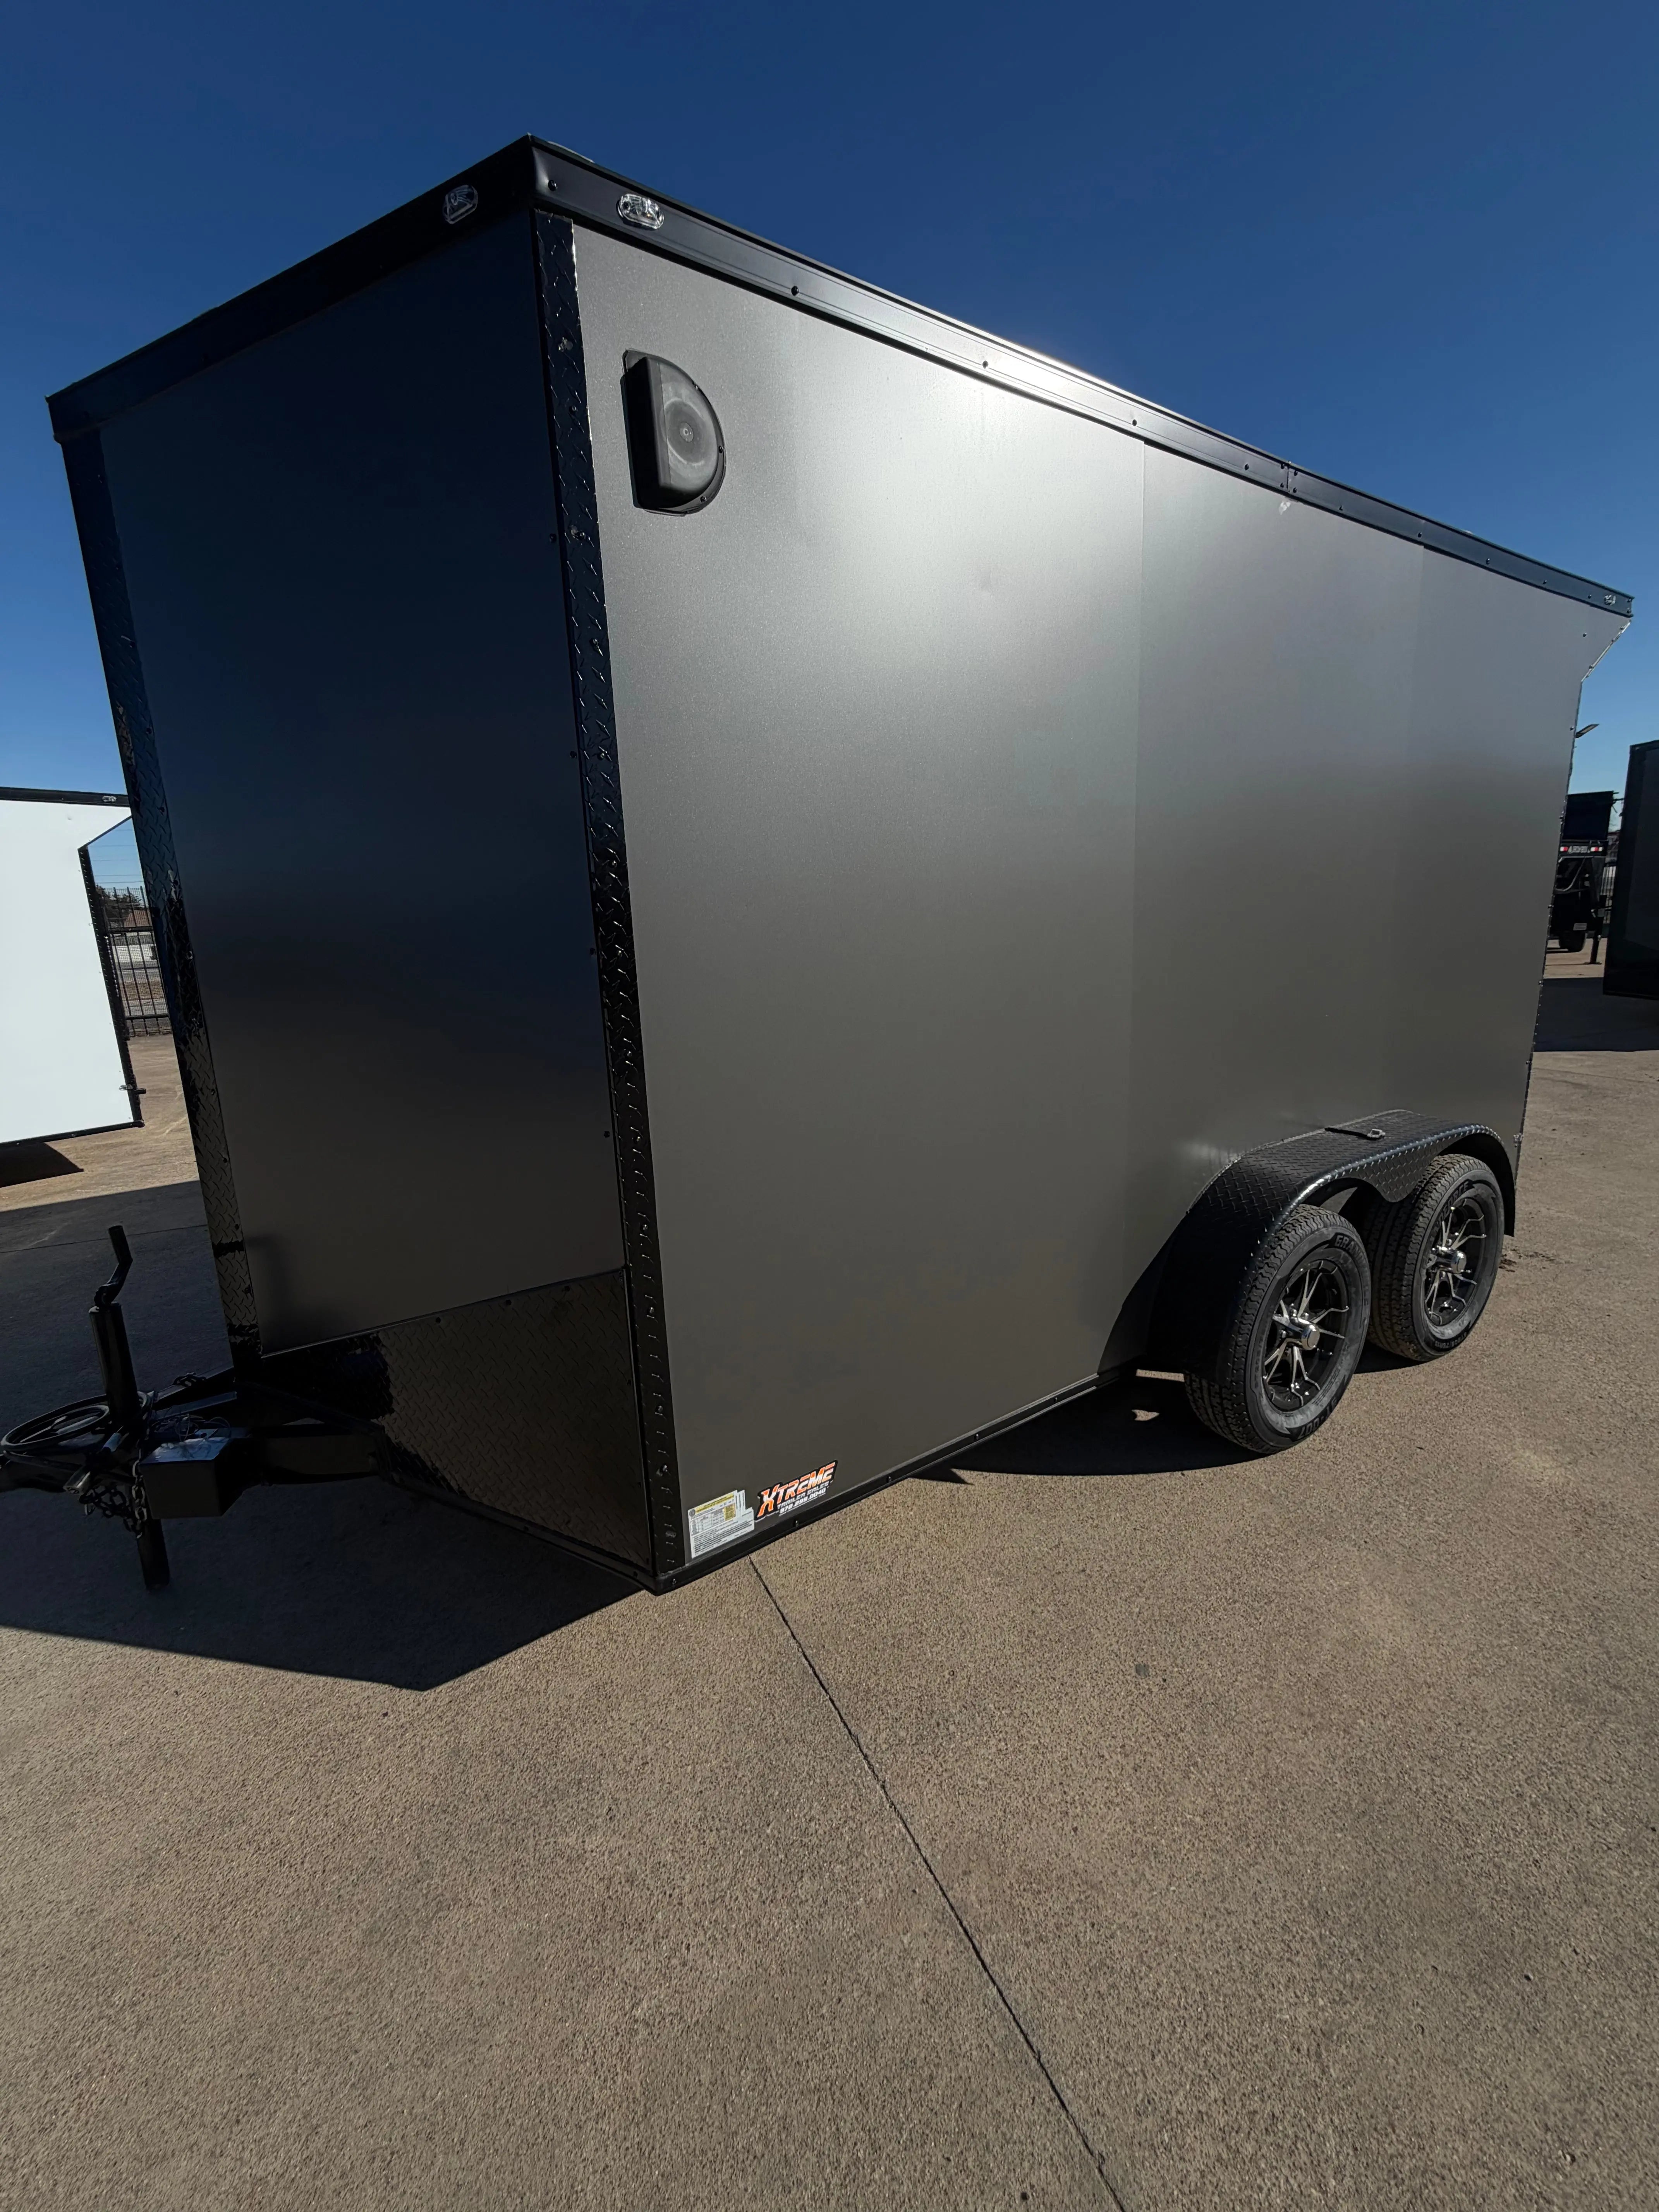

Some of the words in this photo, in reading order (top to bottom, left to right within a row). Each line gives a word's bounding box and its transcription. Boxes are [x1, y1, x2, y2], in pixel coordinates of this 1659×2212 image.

[757, 1462, 836, 1518] XTREME
[777, 1492, 806, 1510] TRAILER
[807, 1481, 830, 1495] SALES
